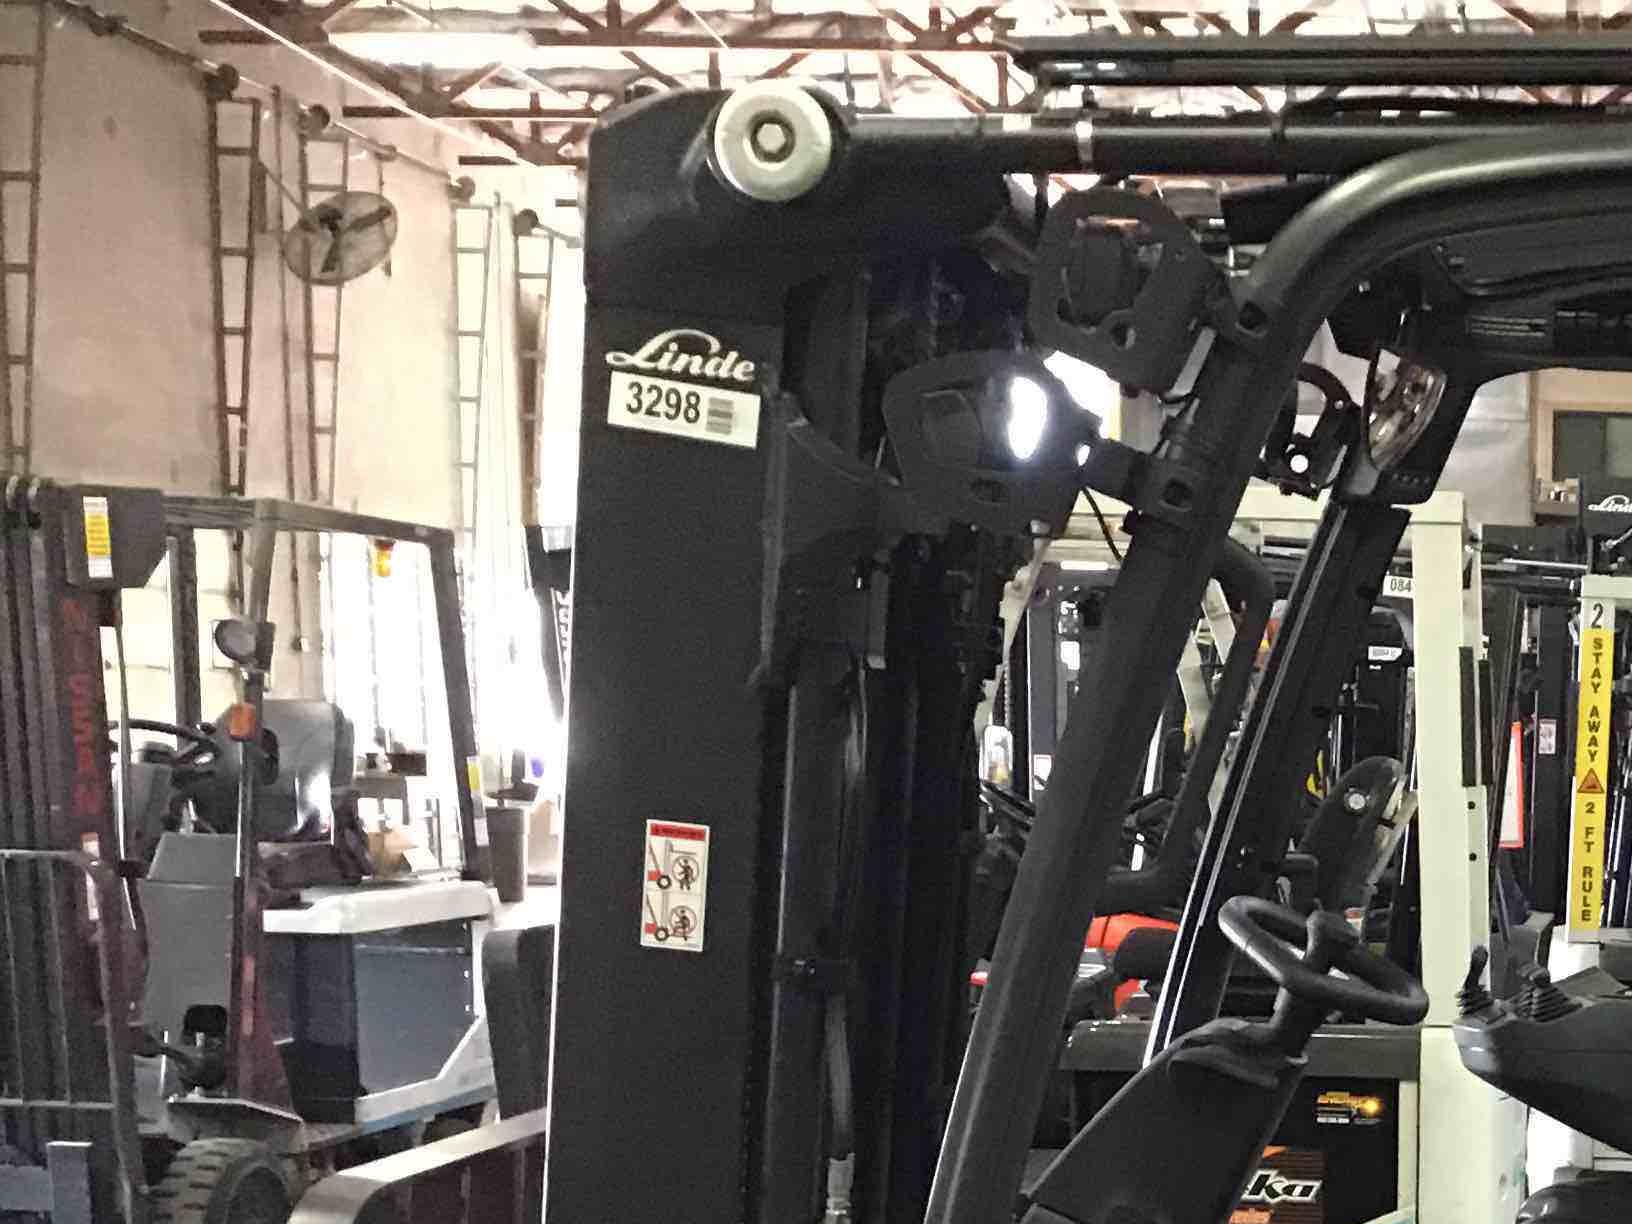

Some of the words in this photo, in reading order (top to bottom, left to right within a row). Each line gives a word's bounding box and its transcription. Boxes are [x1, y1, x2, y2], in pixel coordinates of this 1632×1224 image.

[605, 329, 756, 382] Linde
[625, 381, 701, 425] 3298
[1590, 603, 1604, 629] 2
[1590, 637, 1604, 694] STAY
[1587, 705, 1602, 763] AWAY
[1585, 802, 1596, 815] 2
[1583, 827, 1595, 854] FT
[1581, 866, 1594, 923] RULE
